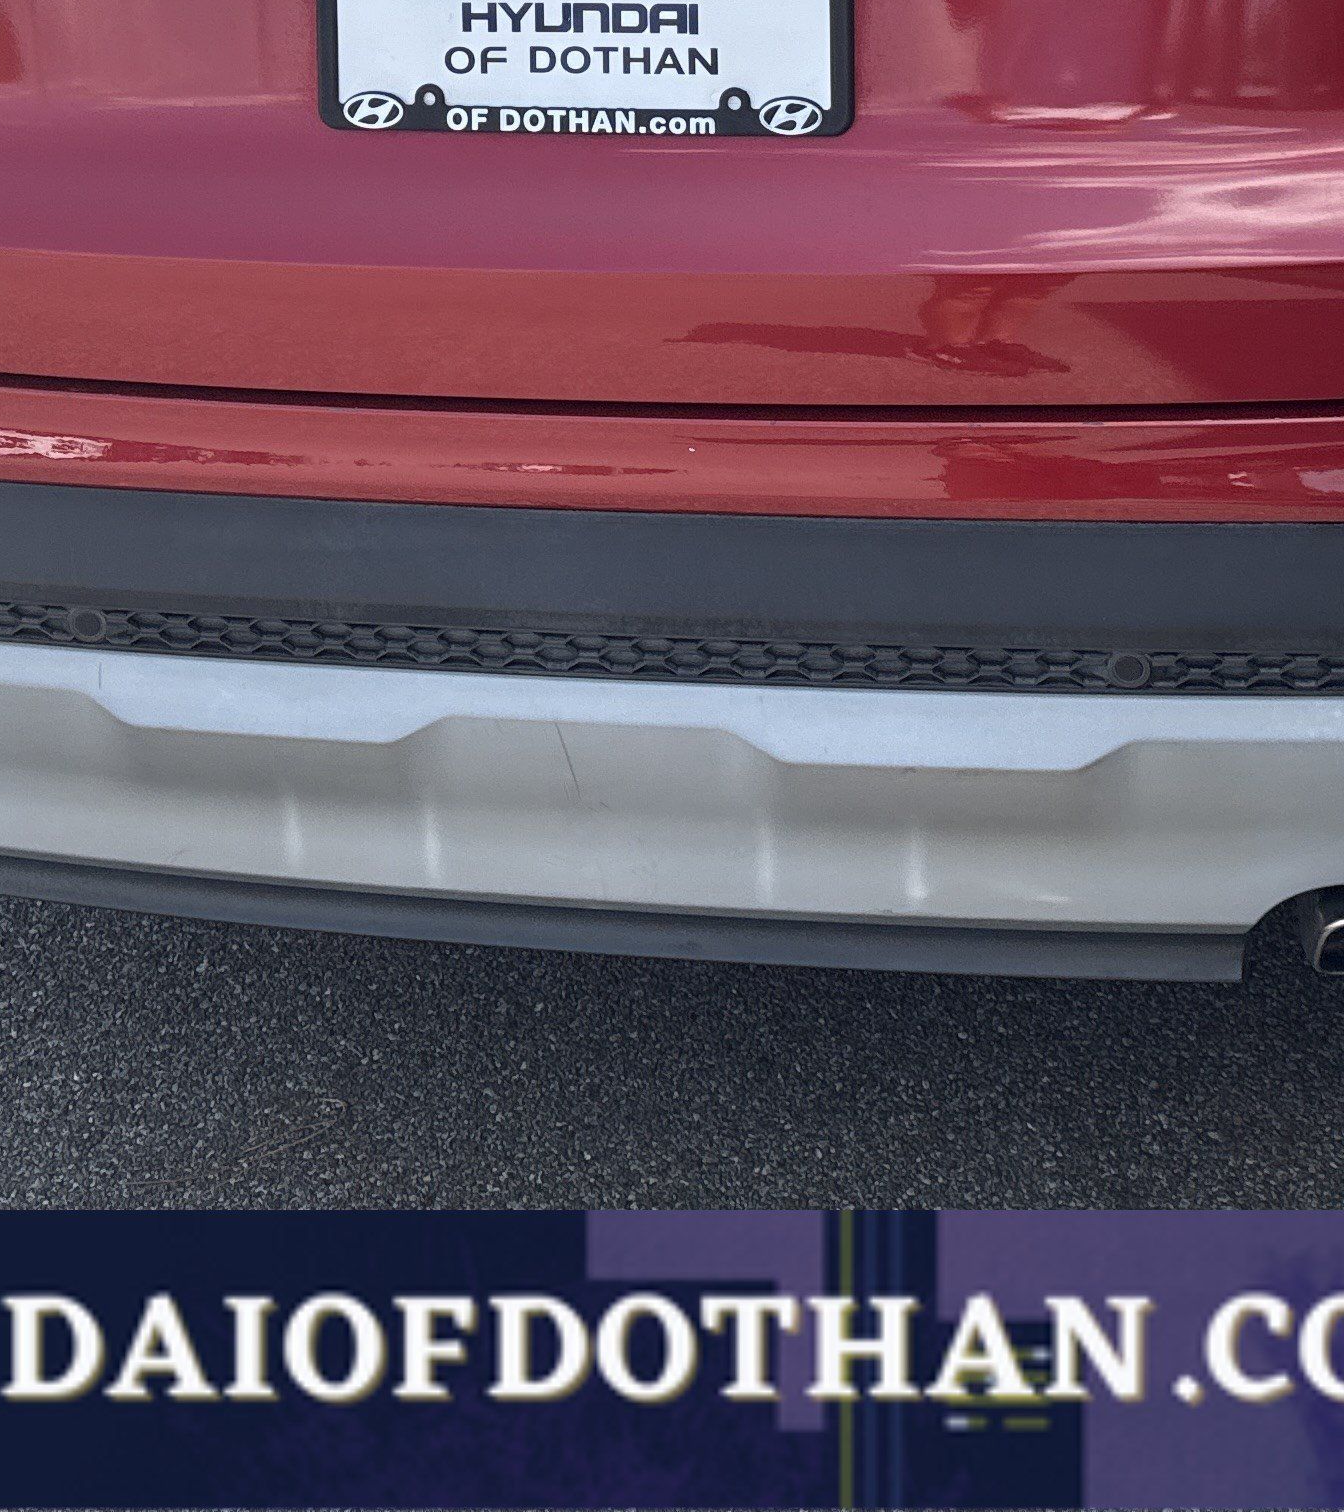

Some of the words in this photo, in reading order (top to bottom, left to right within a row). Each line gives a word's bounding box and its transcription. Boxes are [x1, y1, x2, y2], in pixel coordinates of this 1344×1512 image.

[461, 1, 700, 34] HYUNDAI
[444, 45, 509, 75] OF
[528, 45, 719, 76] DOTHAN
[445, 106, 492, 133] OF
[498, 106, 716, 135] DOTHAN.com
